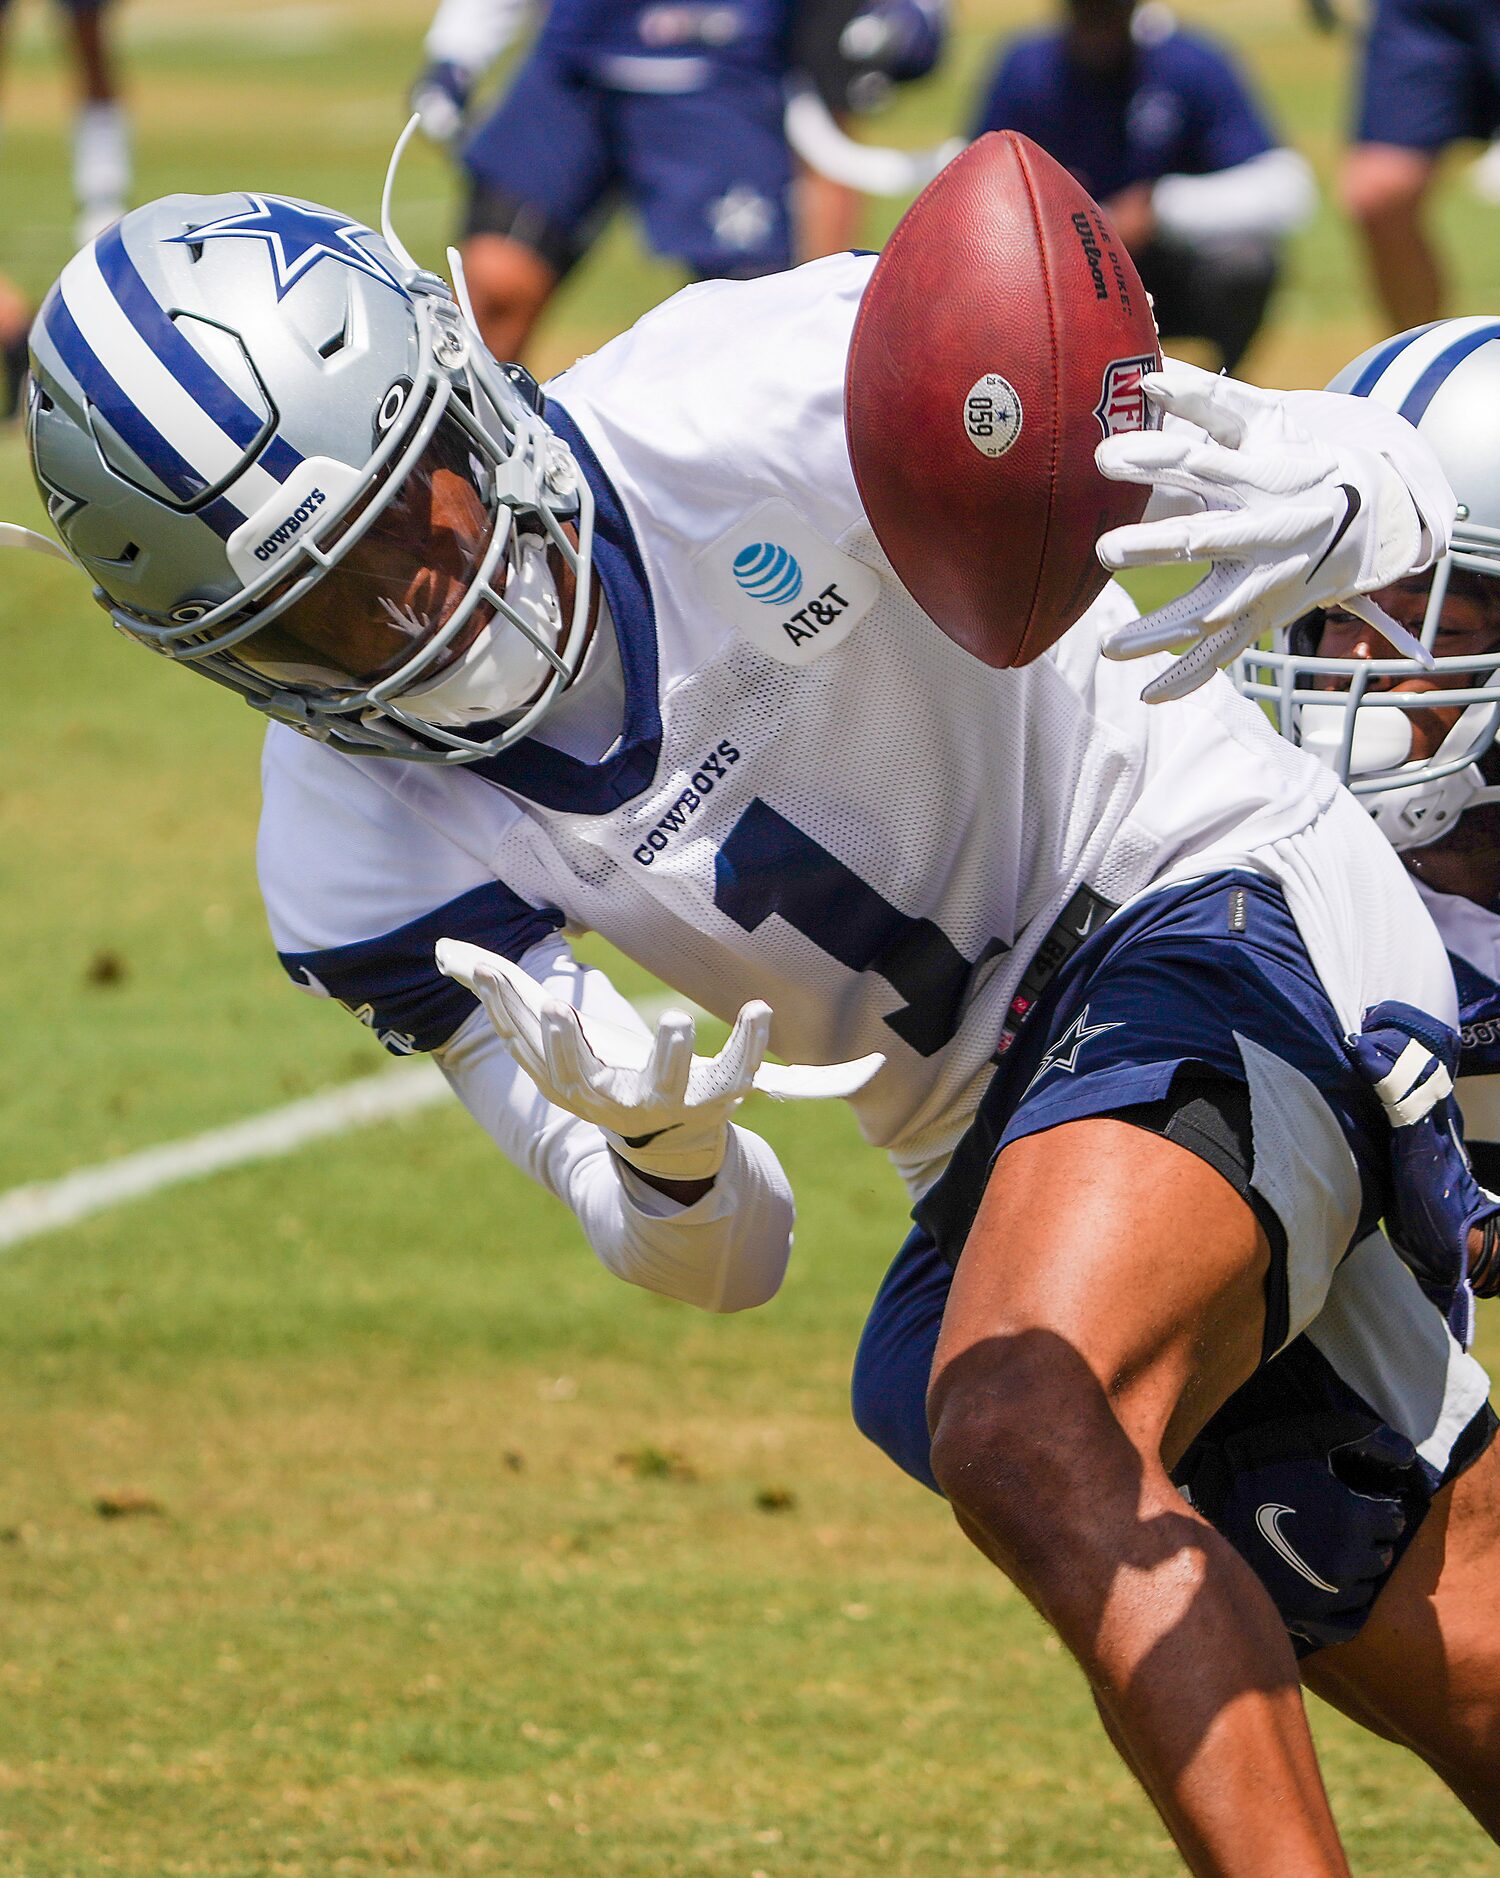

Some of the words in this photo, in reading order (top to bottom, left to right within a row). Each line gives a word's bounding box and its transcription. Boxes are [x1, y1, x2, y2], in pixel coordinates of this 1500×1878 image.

[1072, 212, 1108, 300] Wilson
[968, 398, 993, 436] 059
[1108, 366, 1143, 435] NF
[254, 488, 326, 561] COWBOYS
[782, 583, 849, 647] AT&T
[633, 740, 740, 866] COWBOYS
[713, 796, 972, 1057] 1
